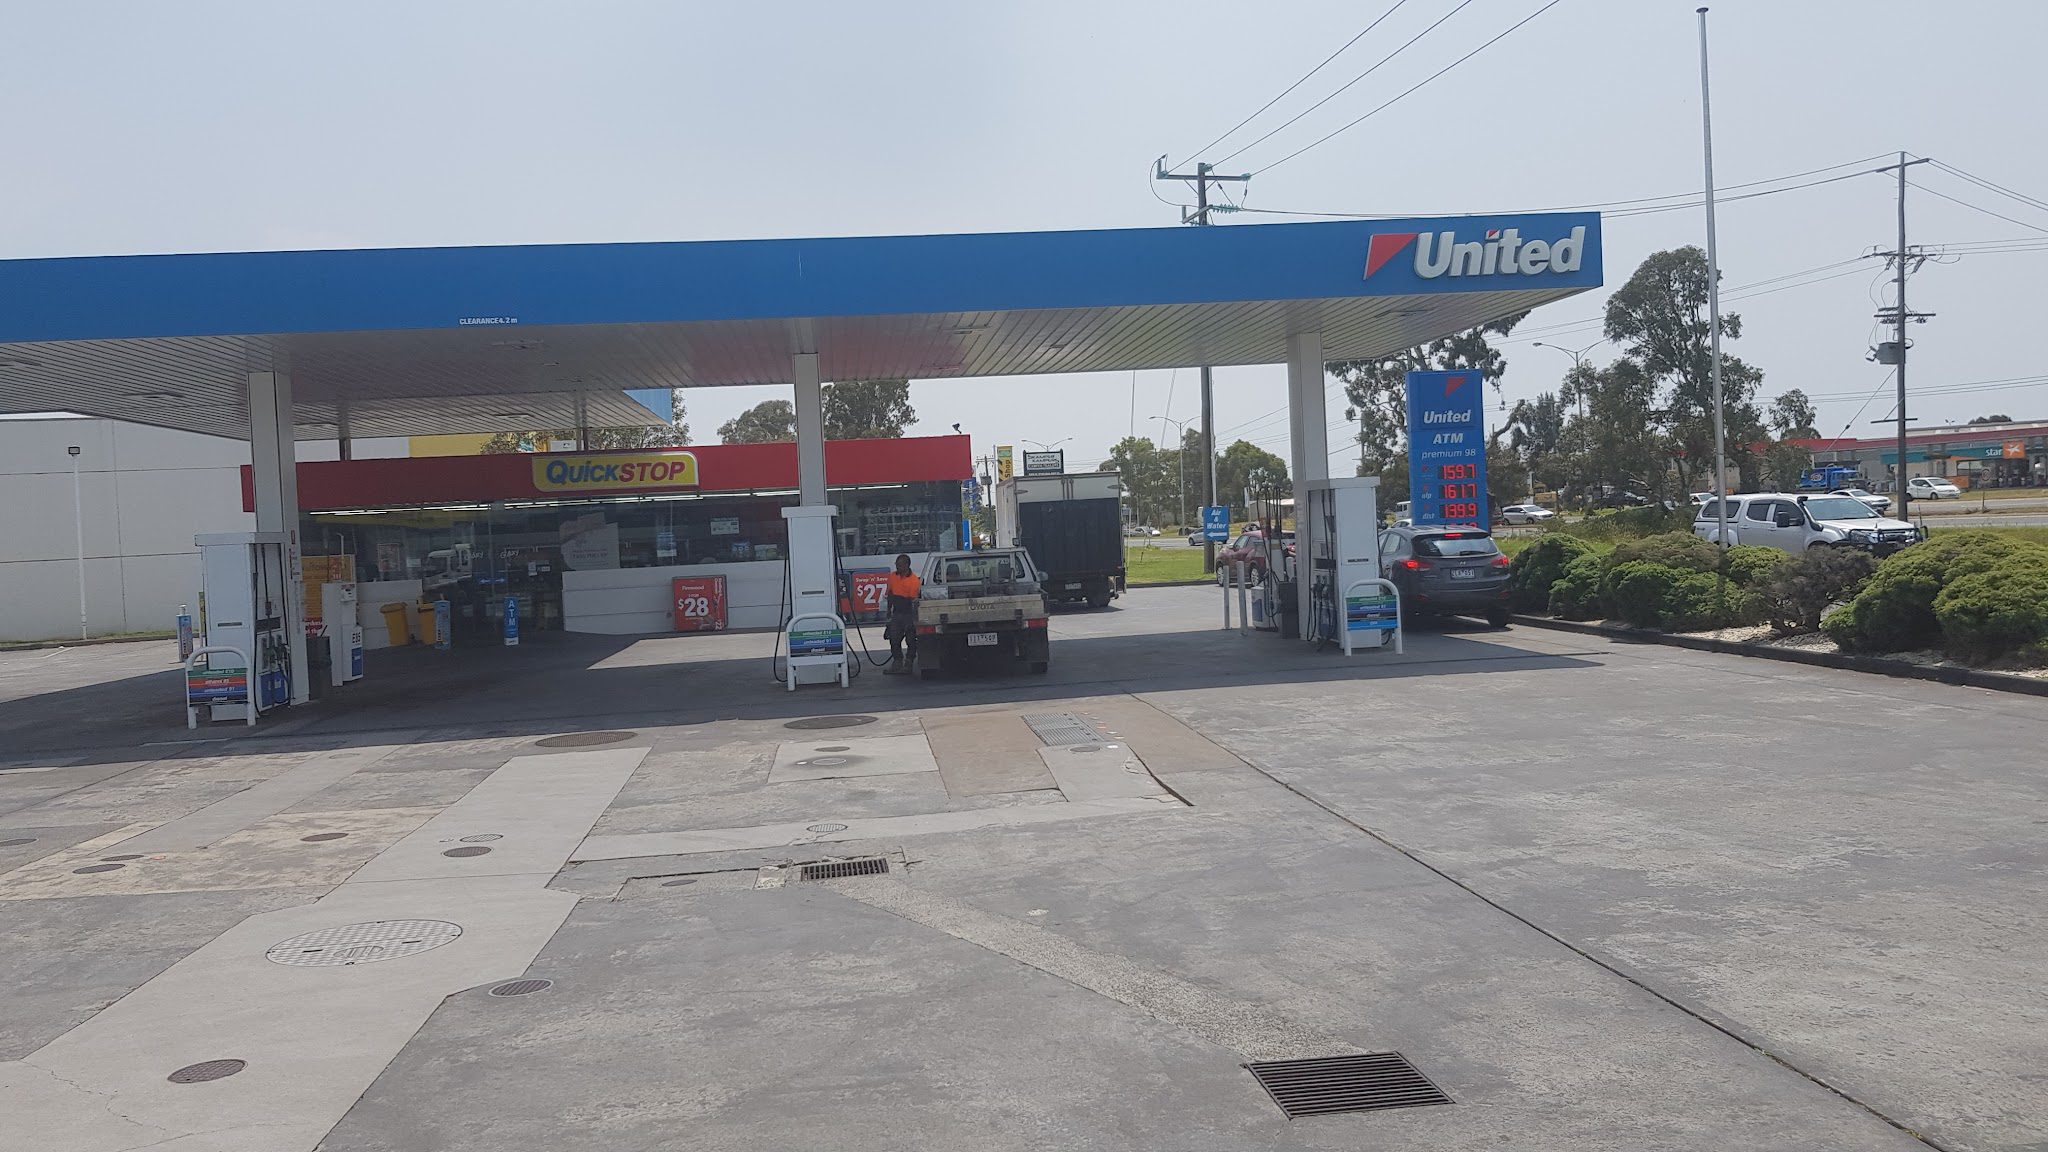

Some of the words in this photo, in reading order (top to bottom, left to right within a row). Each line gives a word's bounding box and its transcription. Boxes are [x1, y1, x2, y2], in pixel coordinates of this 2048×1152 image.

[1414, 226, 1586, 279] United
[1424, 409, 1472, 424] United
[1433, 433, 1464, 445] ATM
[1421, 450, 1462, 460] premium
[1464, 449, 1476, 457] 98
[1985, 448, 2002, 457] star
[1444, 503, 1477, 518] 139.9
[508, 600, 516, 626] ATM
[678, 597, 709, 617] $28
